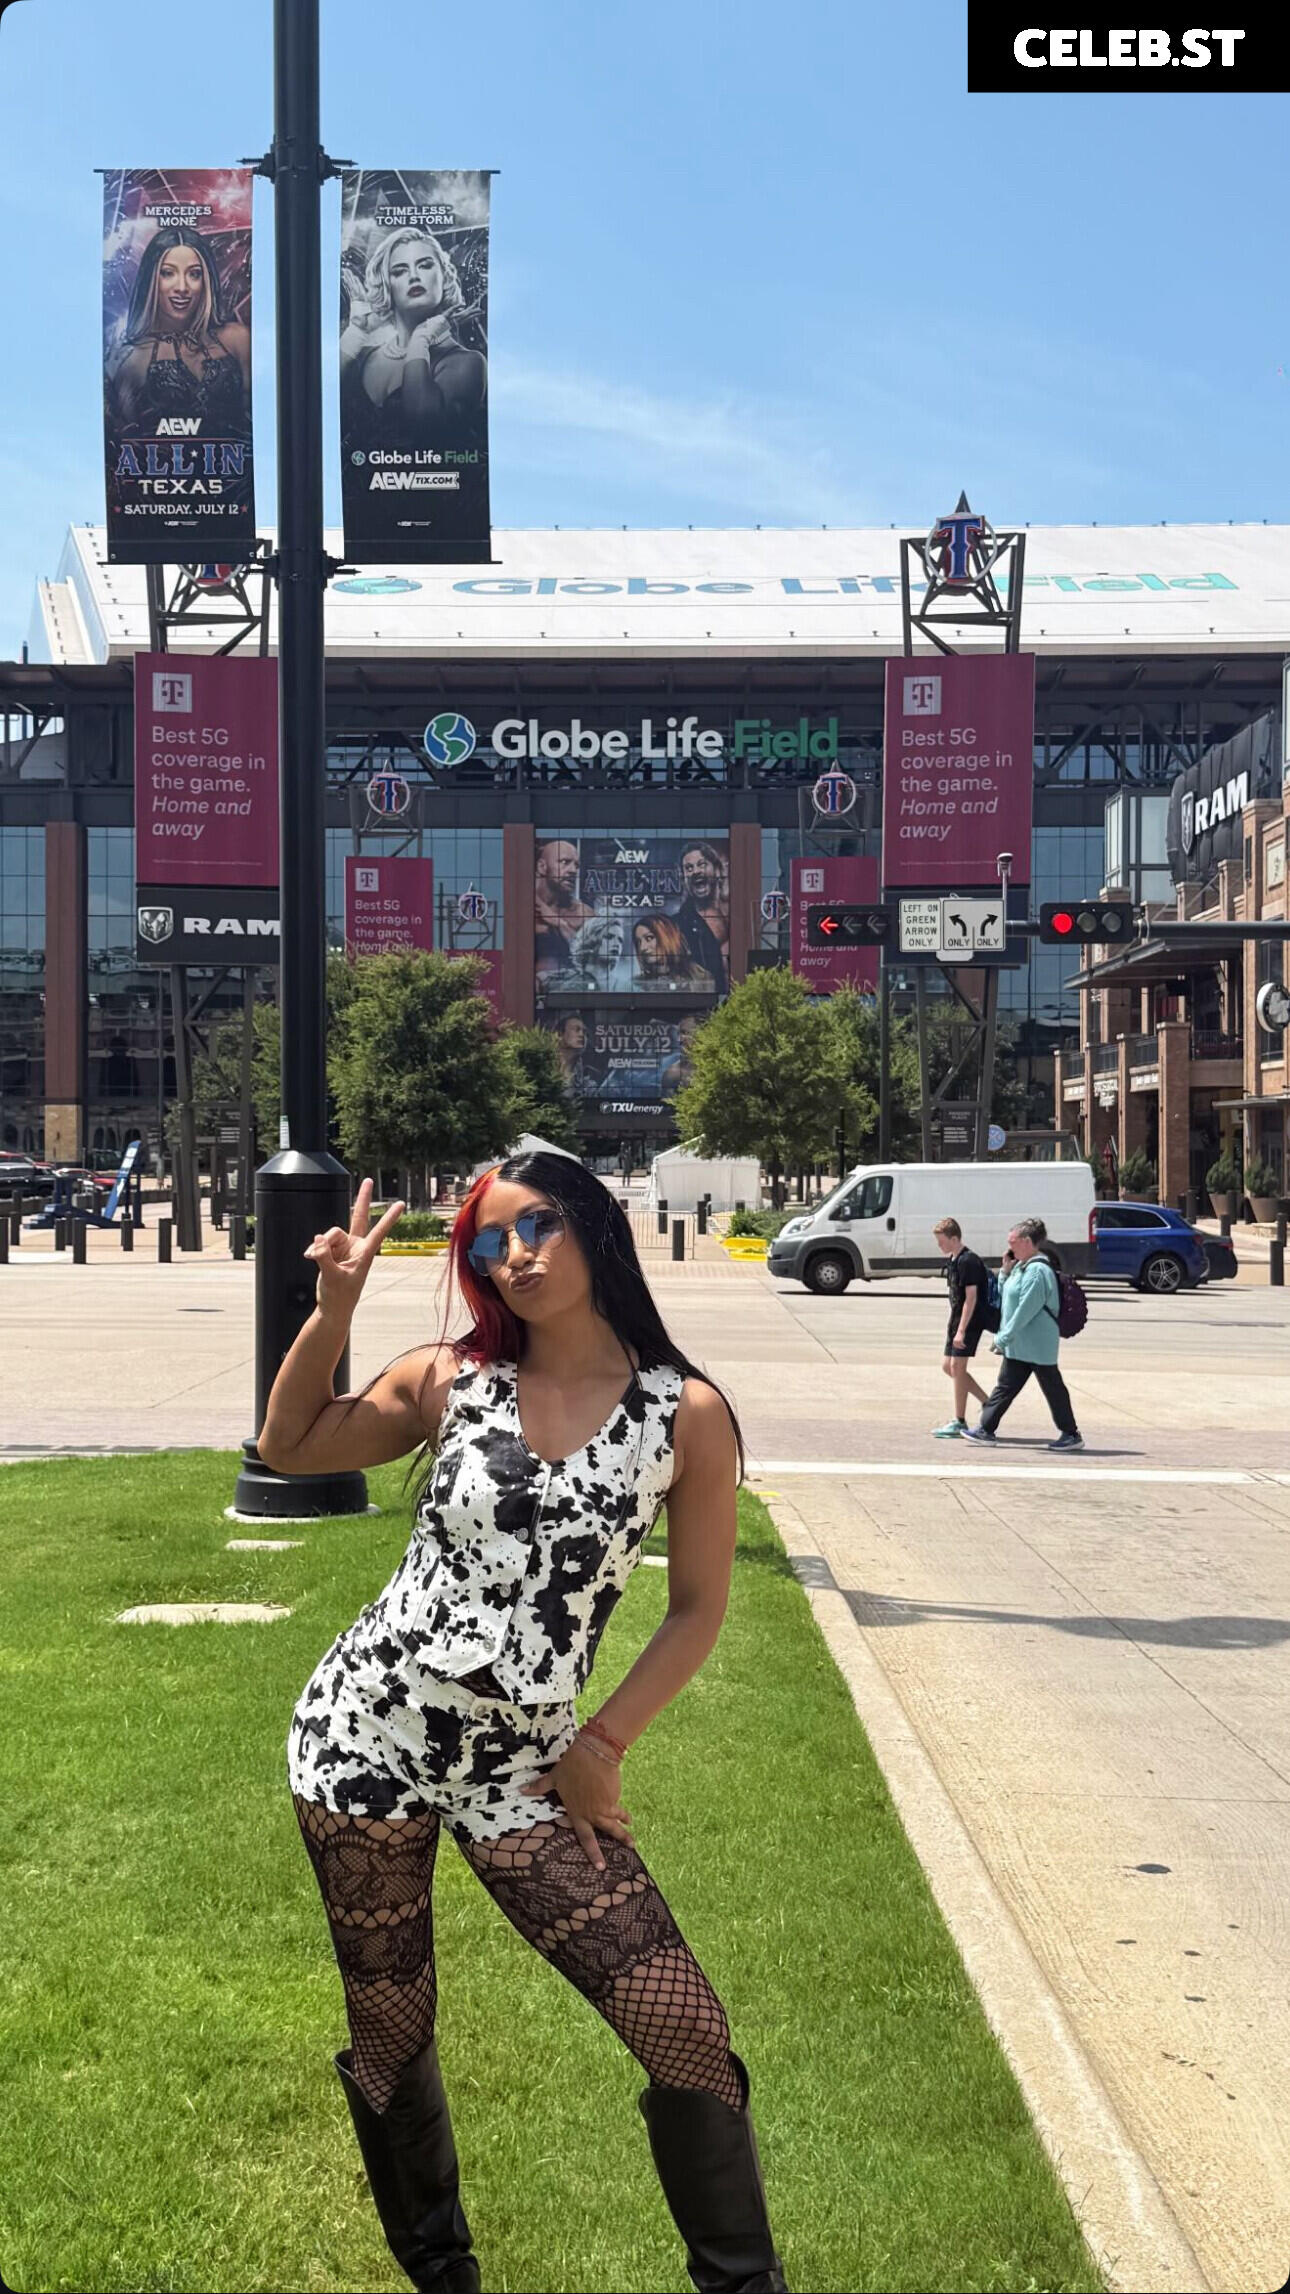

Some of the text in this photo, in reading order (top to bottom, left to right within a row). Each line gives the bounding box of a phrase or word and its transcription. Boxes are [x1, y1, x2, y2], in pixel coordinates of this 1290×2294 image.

[145, 206, 212, 216] MERCEDES
[376, 216, 454, 226] TONI STORM
[155, 417, 202, 436] AEW
[115, 443, 245, 475] ALL IN
[368, 450, 479, 464] Globe Life Field
[138, 479, 223, 495] TEXAS
[195, 504, 226, 515] JULY
[229, 504, 239, 515] 12
[452, 577, 754, 596] Globe
[152, 725, 229, 746] Best 5G
[491, 716, 838, 759] Globe Life Field
[902, 727, 977, 747] Best 5G
[151, 753, 266, 773] coverage in
[900, 750, 1013, 772] coverage in
[151, 773, 252, 795] the game.
[900, 776, 999, 796] the game.
[152, 795, 253, 816] Home and
[900, 797, 999, 816] Home and
[1194, 770, 1250, 836] RAM
[152, 822, 206, 841] away
[899, 824, 952, 842] away
[614, 850, 650, 864] AEW
[354, 899, 401, 911] Best 5G
[600, 894, 665, 907] TEXAS
[903, 904, 939, 913] LEFT ON
[183, 917, 281, 936] RAM
[354, 914, 423, 927] coverage in
[905, 915, 937, 924] GREEN
[354, 928, 375, 939] the
[904, 926, 938, 936] ARROW
[908, 938, 934, 947] ONLY
[947, 938, 1000, 947] ONLY ONLY
[799, 957, 832, 968] away
[595, 1024, 670, 1036] SATURDAY
[594, 1036, 672, 1054] JULY 12
